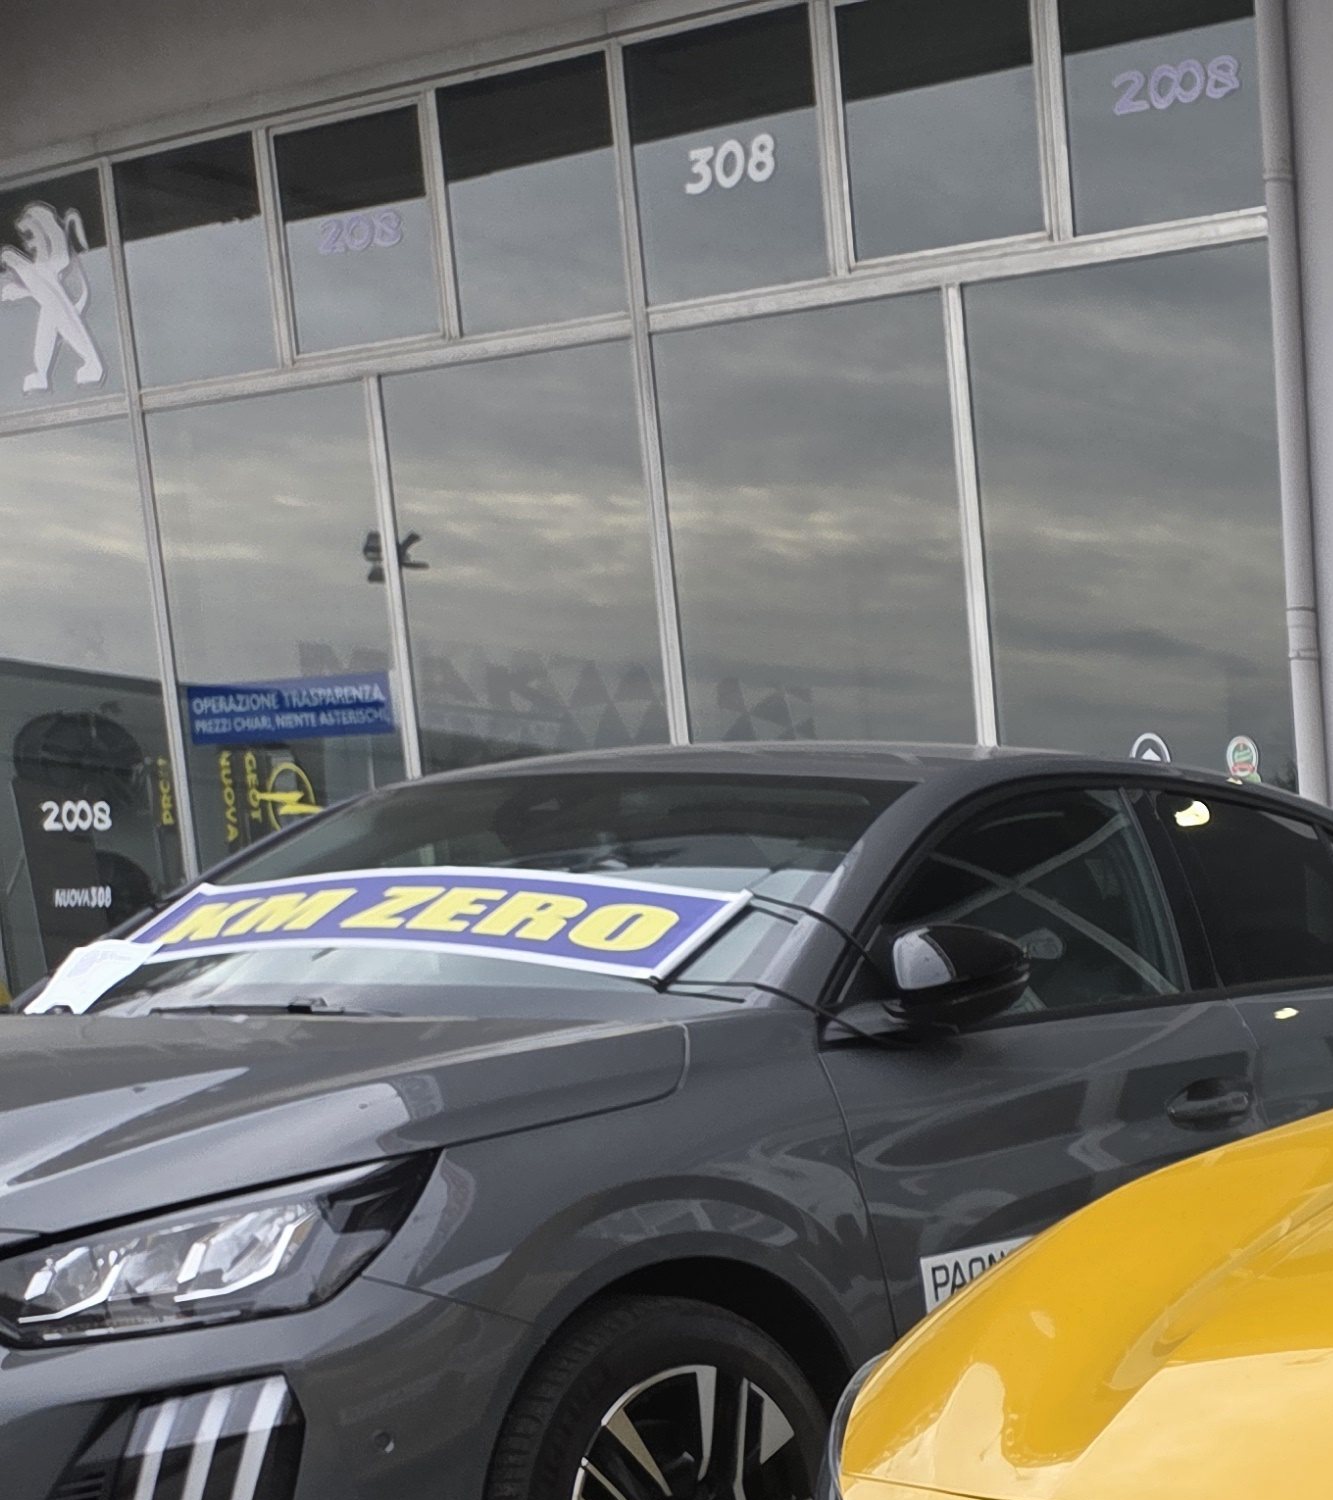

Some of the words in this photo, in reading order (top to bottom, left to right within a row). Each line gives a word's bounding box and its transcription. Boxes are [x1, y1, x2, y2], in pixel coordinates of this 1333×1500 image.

[1112, 55, 1240, 117] 2008
[684, 132, 776, 196] 308
[317, 210, 403, 256] 208
[192, 693, 279, 716] OPERAZIONE
[194, 717, 232, 735] PREZZI
[275, 712, 318, 730] NIENTE
[40, 799, 112, 832] 2008
[155, 888, 358, 946] KM
[341, 885, 680, 952] ZERO
[931, 1250, 1006, 1302] PAO
